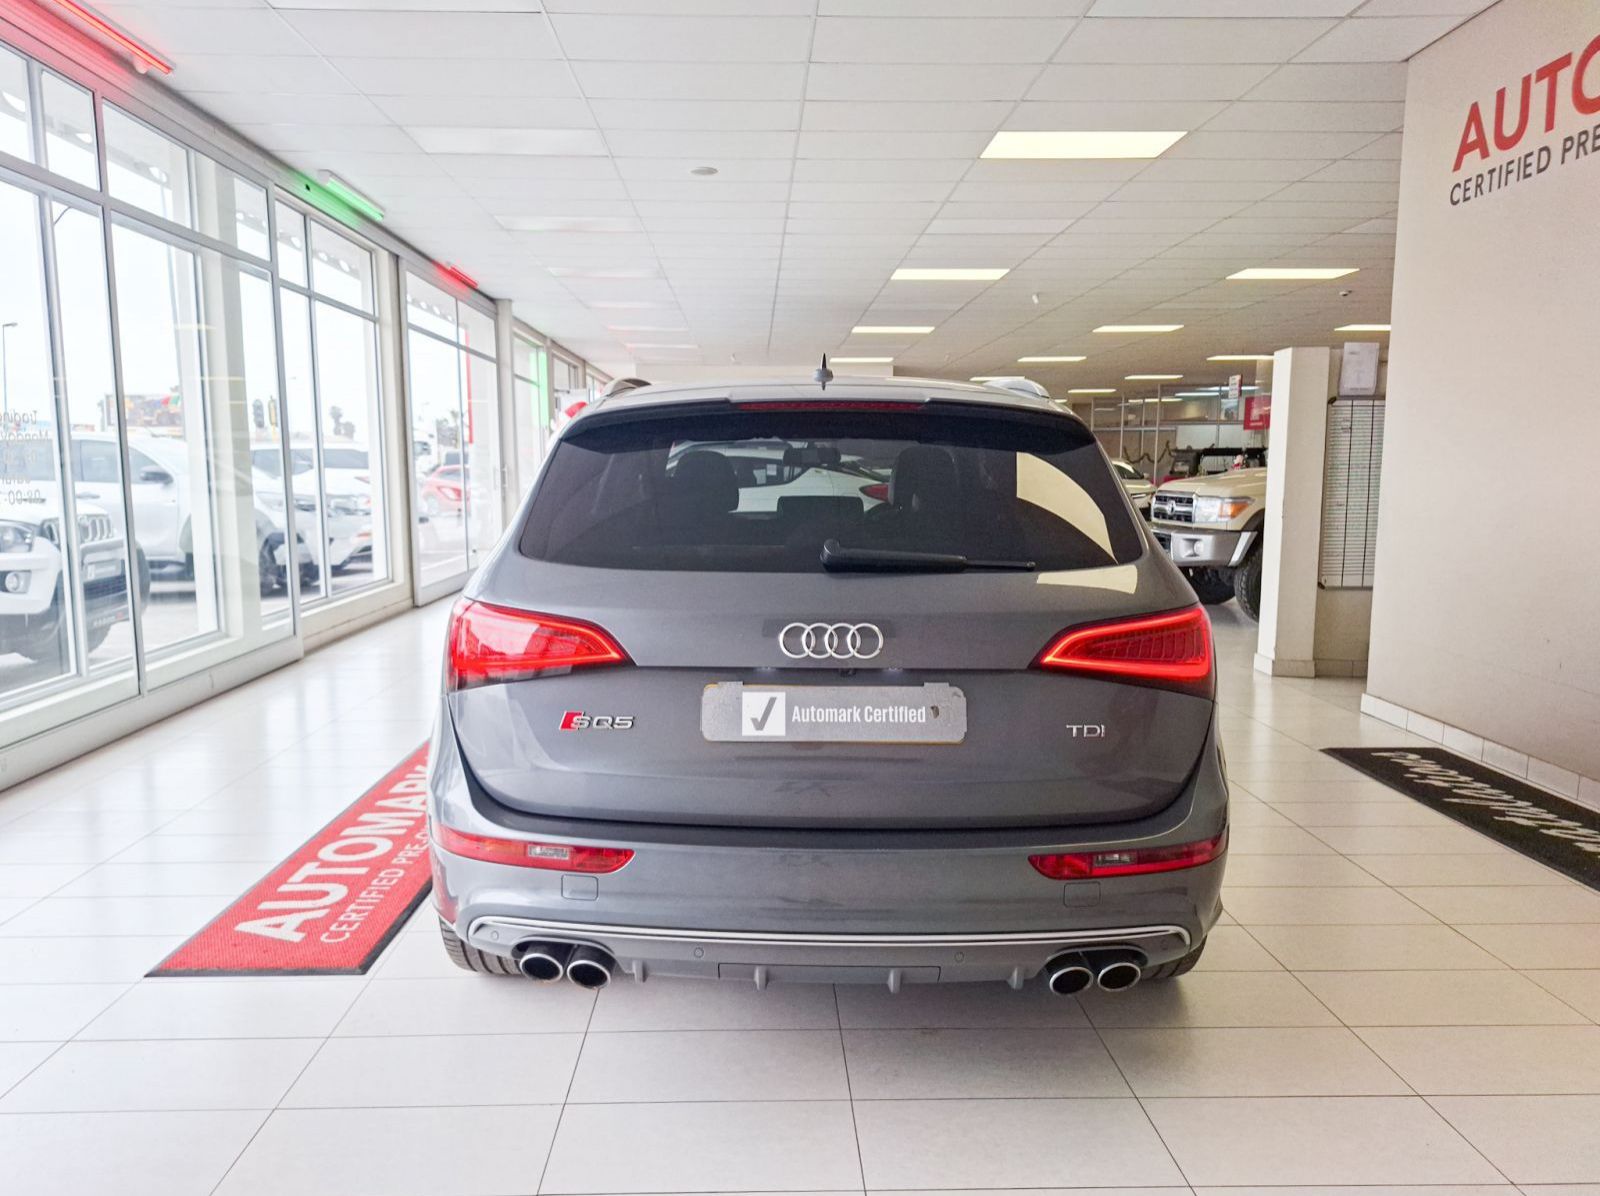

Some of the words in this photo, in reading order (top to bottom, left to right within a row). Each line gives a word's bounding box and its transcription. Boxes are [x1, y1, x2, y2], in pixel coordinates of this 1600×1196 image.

[1450, 145, 1551, 206] CERTIFIED
[565, 714, 635, 730] SQ5
[791, 705, 860, 723] Automark
[864, 705, 926, 723] Certified
[1066, 724, 1106, 738] TDI
[320, 868, 404, 943] CERTIFIED
